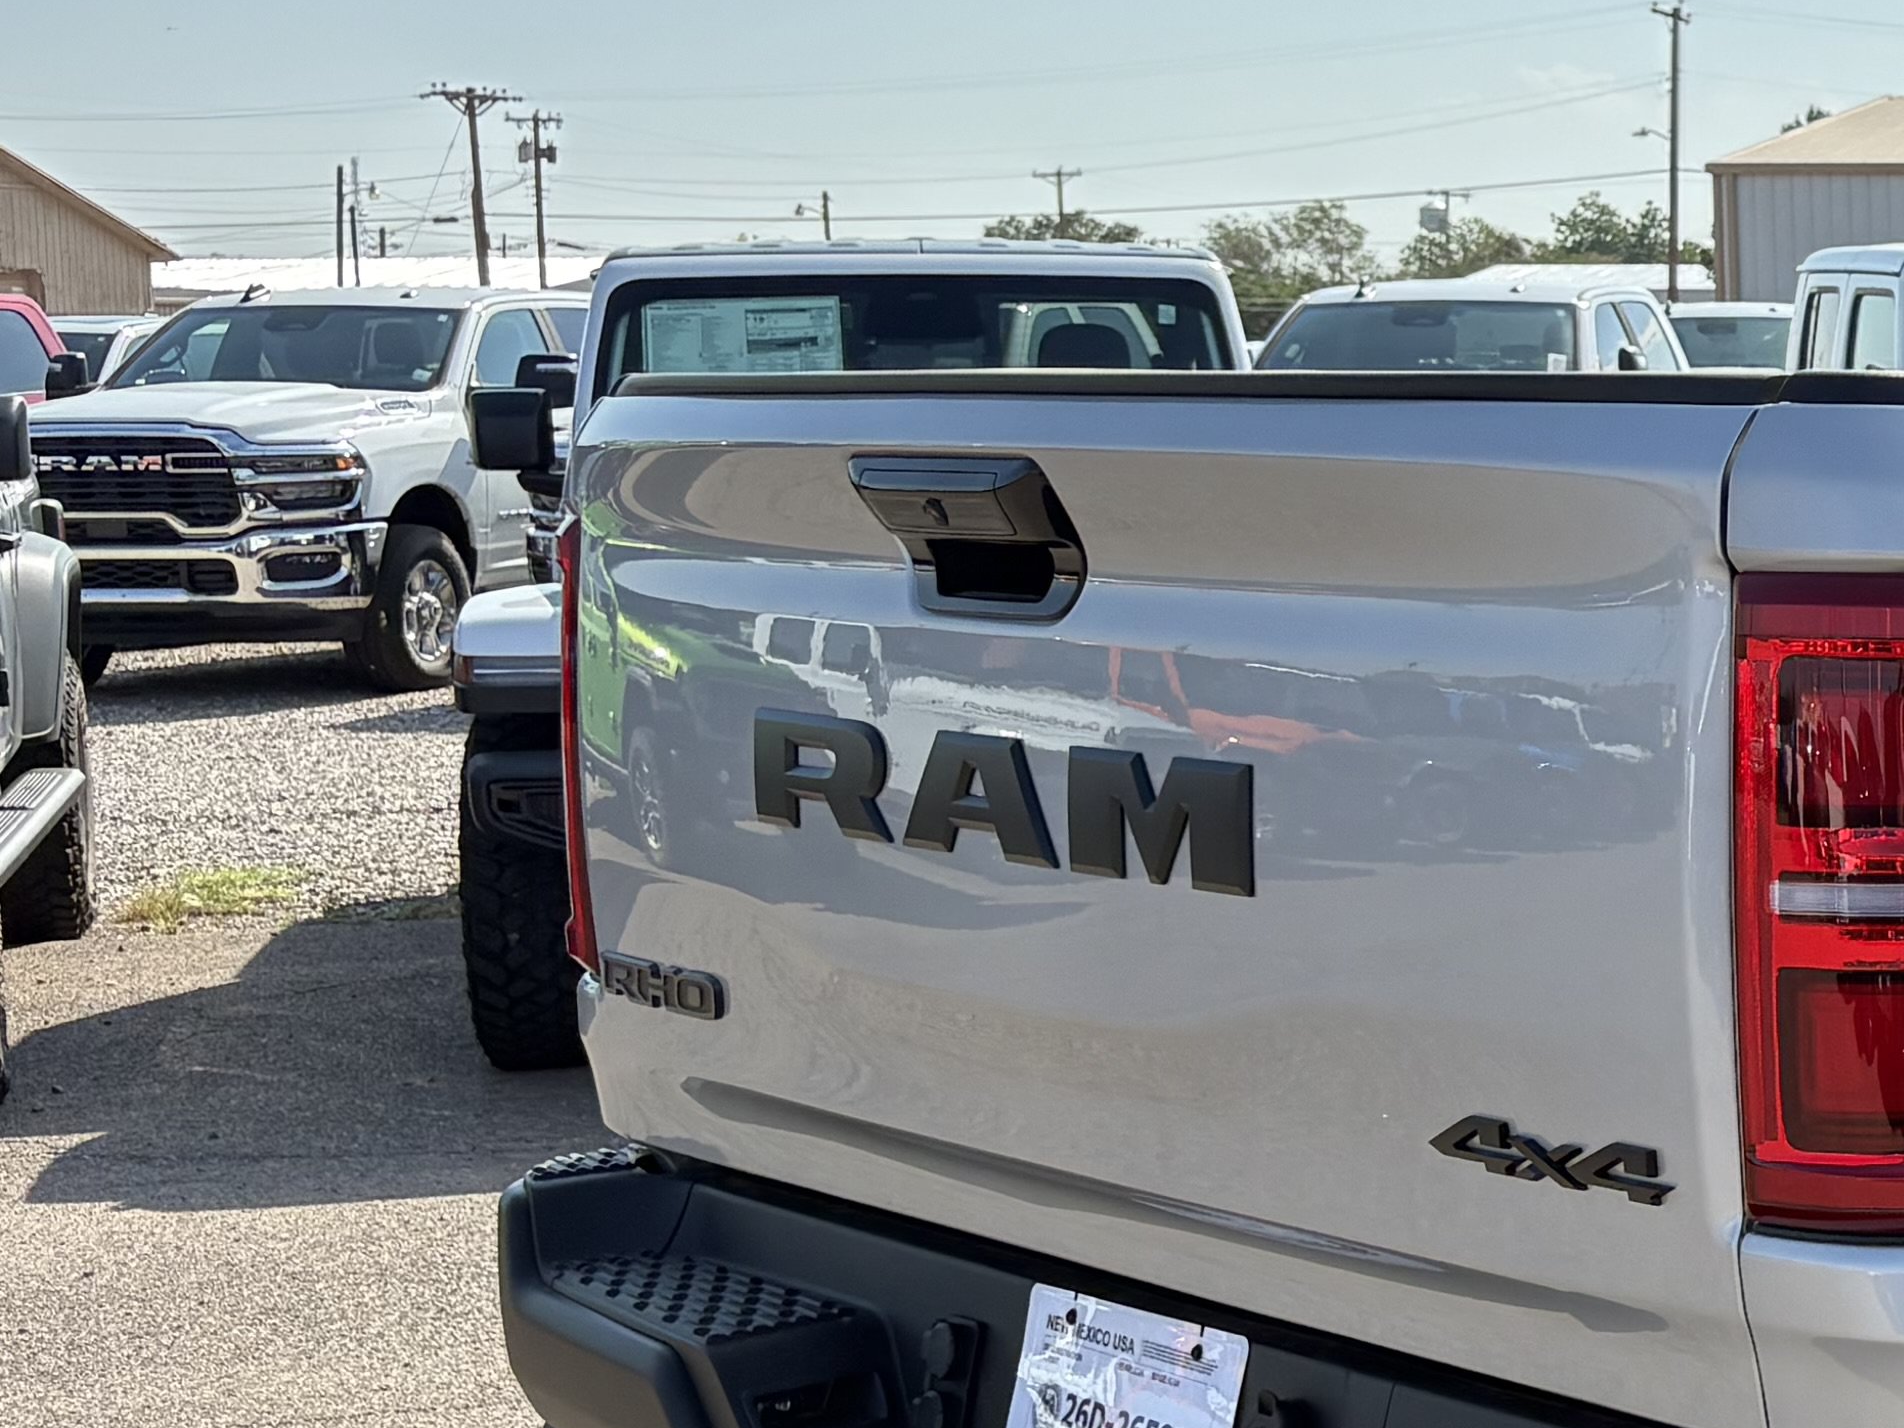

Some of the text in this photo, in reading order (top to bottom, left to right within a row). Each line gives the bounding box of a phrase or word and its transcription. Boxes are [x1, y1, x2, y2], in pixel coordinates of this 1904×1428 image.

[39, 455, 162, 471] RAM
[754, 707, 1256, 897] RAM
[600, 950, 726, 1021] RHO
[1113, 1333, 1135, 1355] USA
